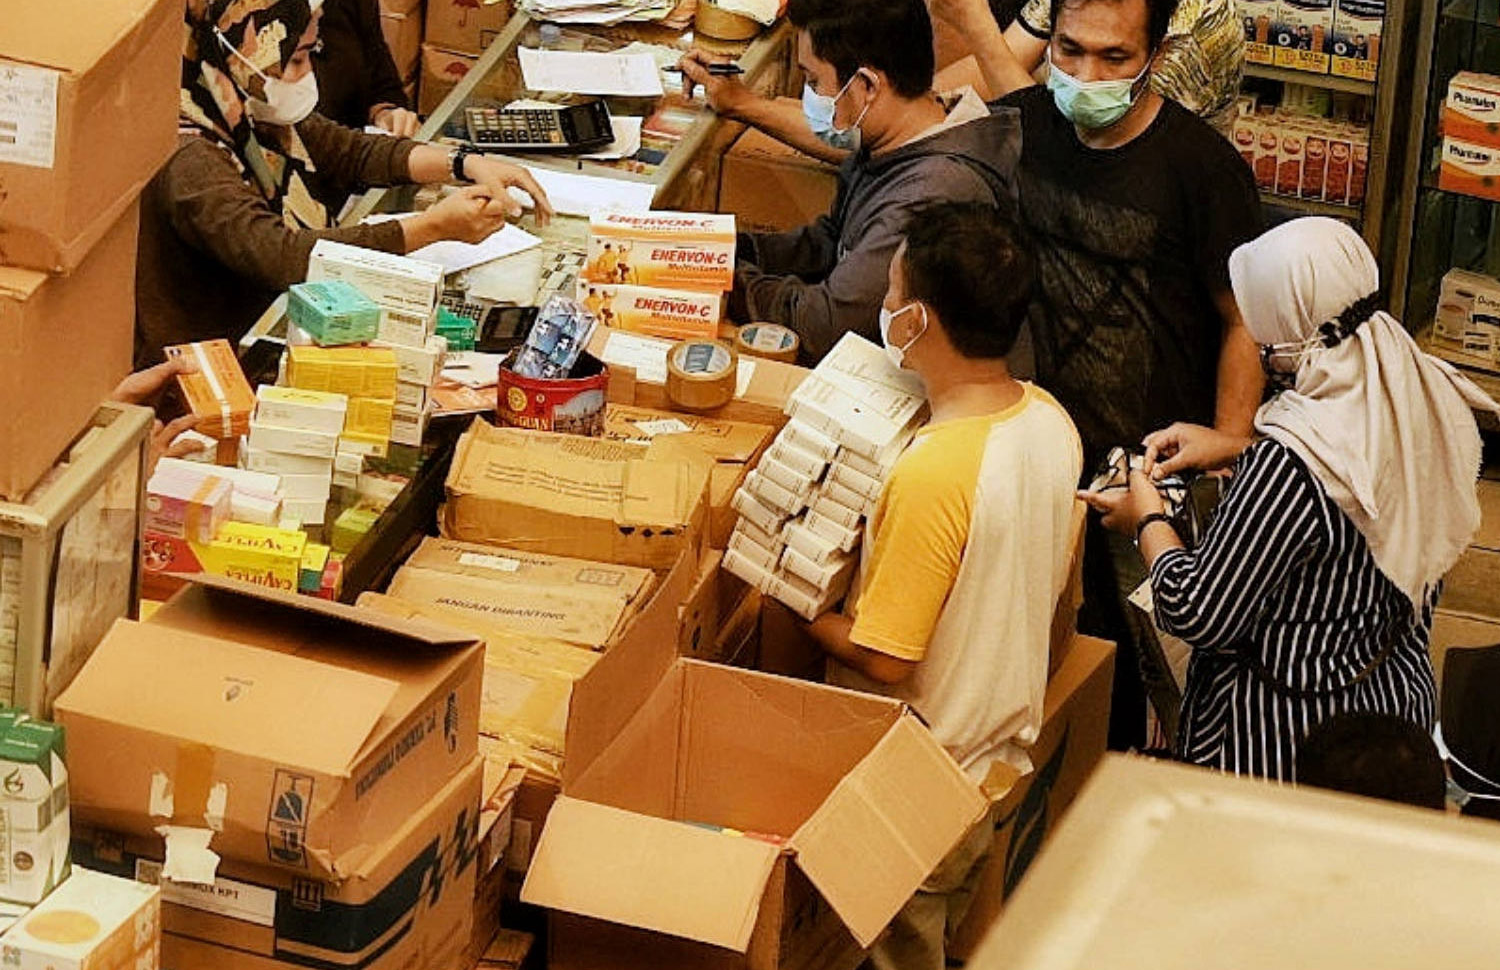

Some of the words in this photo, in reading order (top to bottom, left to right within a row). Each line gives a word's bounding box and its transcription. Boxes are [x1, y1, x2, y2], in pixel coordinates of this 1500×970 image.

[651, 249, 729, 266] ENERVON-C
[668, 262, 728, 274] Multivitamin
[634, 297, 711, 319] ENERVON-C
